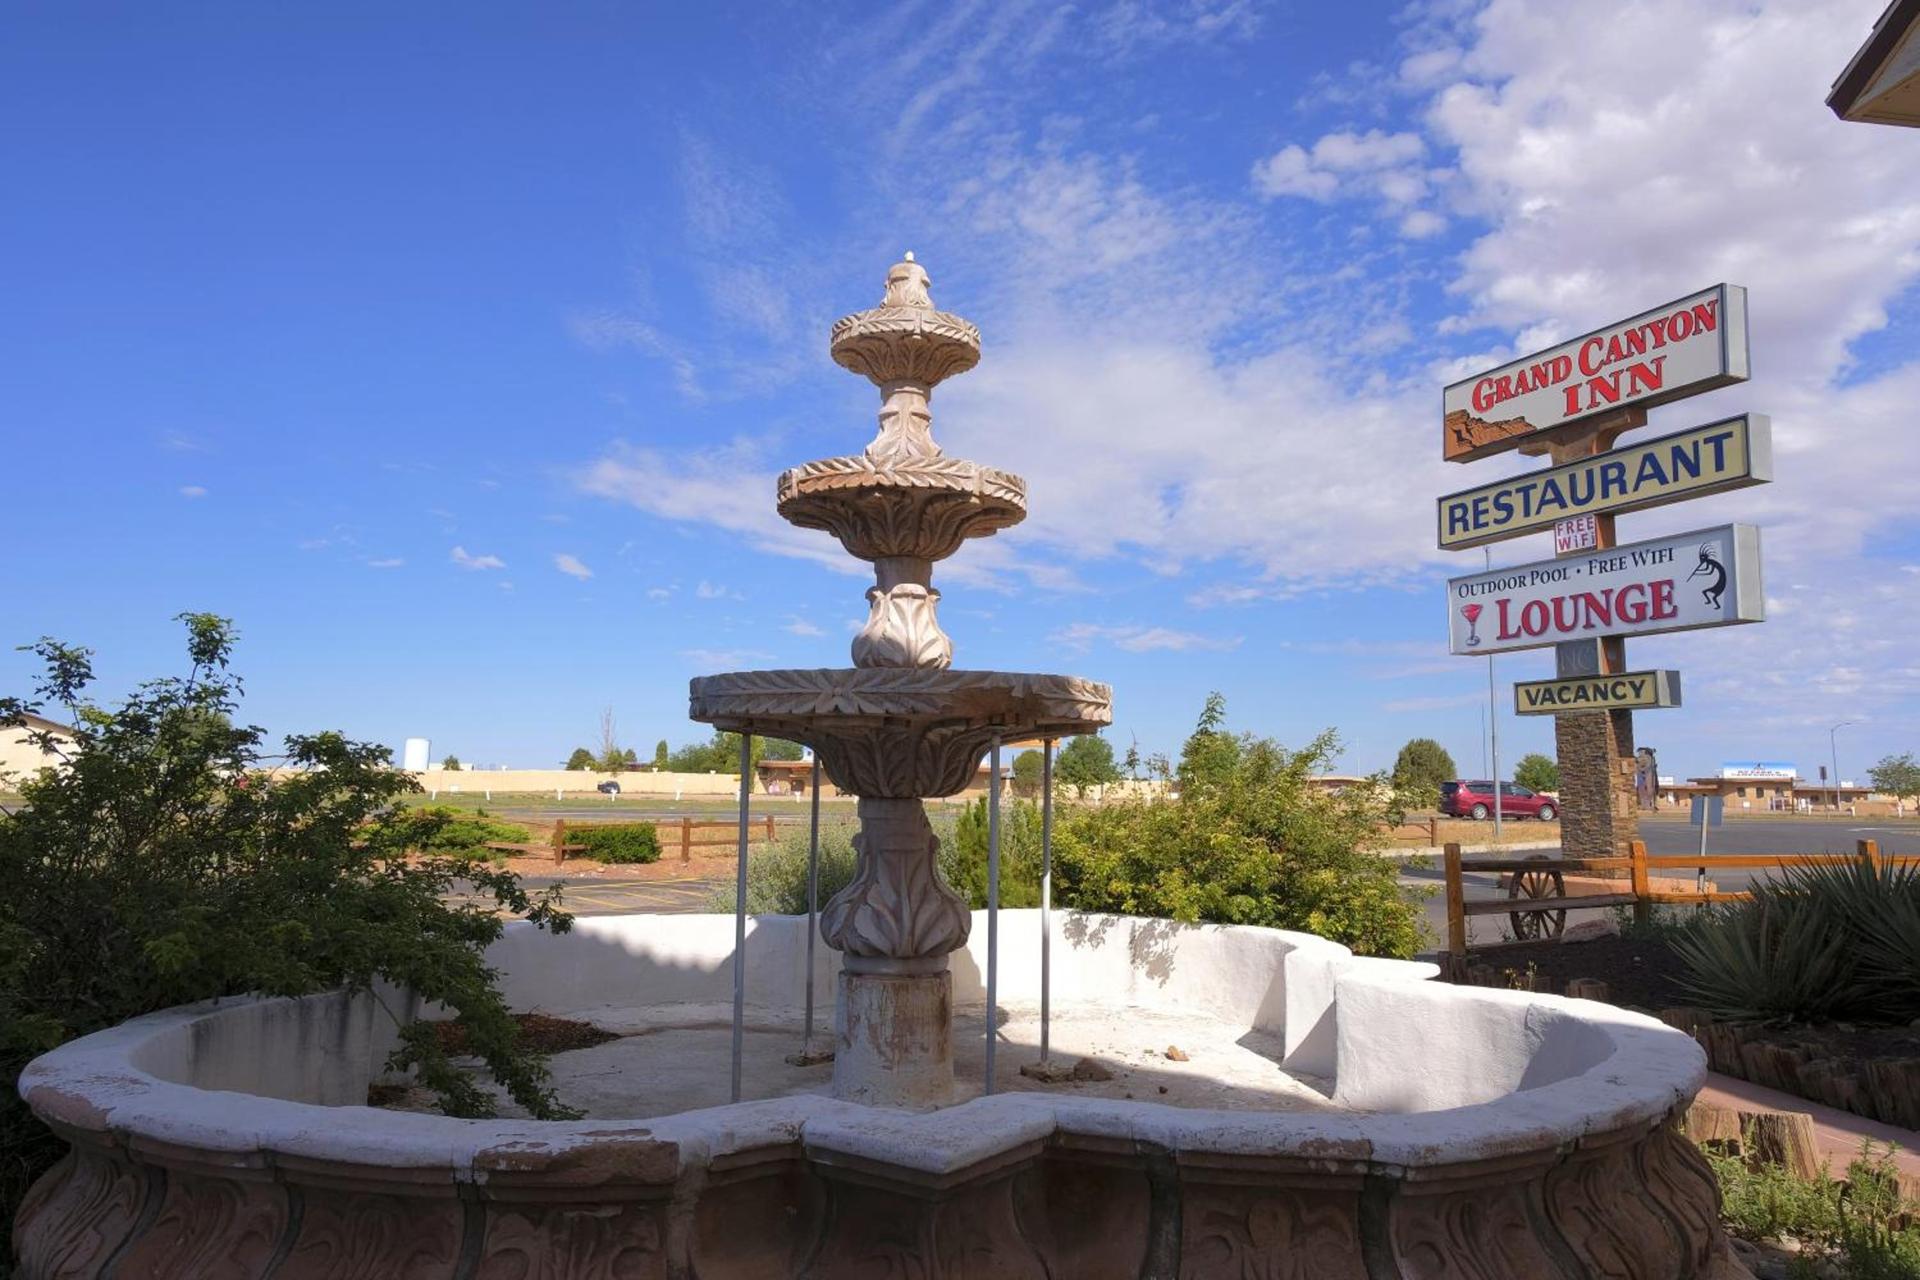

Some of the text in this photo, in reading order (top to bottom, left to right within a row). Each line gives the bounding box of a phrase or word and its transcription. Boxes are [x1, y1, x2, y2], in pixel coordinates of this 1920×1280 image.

[1471, 299, 1718, 413] GRAND CANYON
[1562, 355, 1667, 418] INN
[1448, 431, 1734, 536] RESTAURANT
[1557, 516, 1594, 537] FREE
[1458, 547, 1674, 599] OUTDOOR POOL FREE WIFI
[1495, 578, 1678, 641] LOUNGE
[1524, 680, 1647, 707] VACANCY
